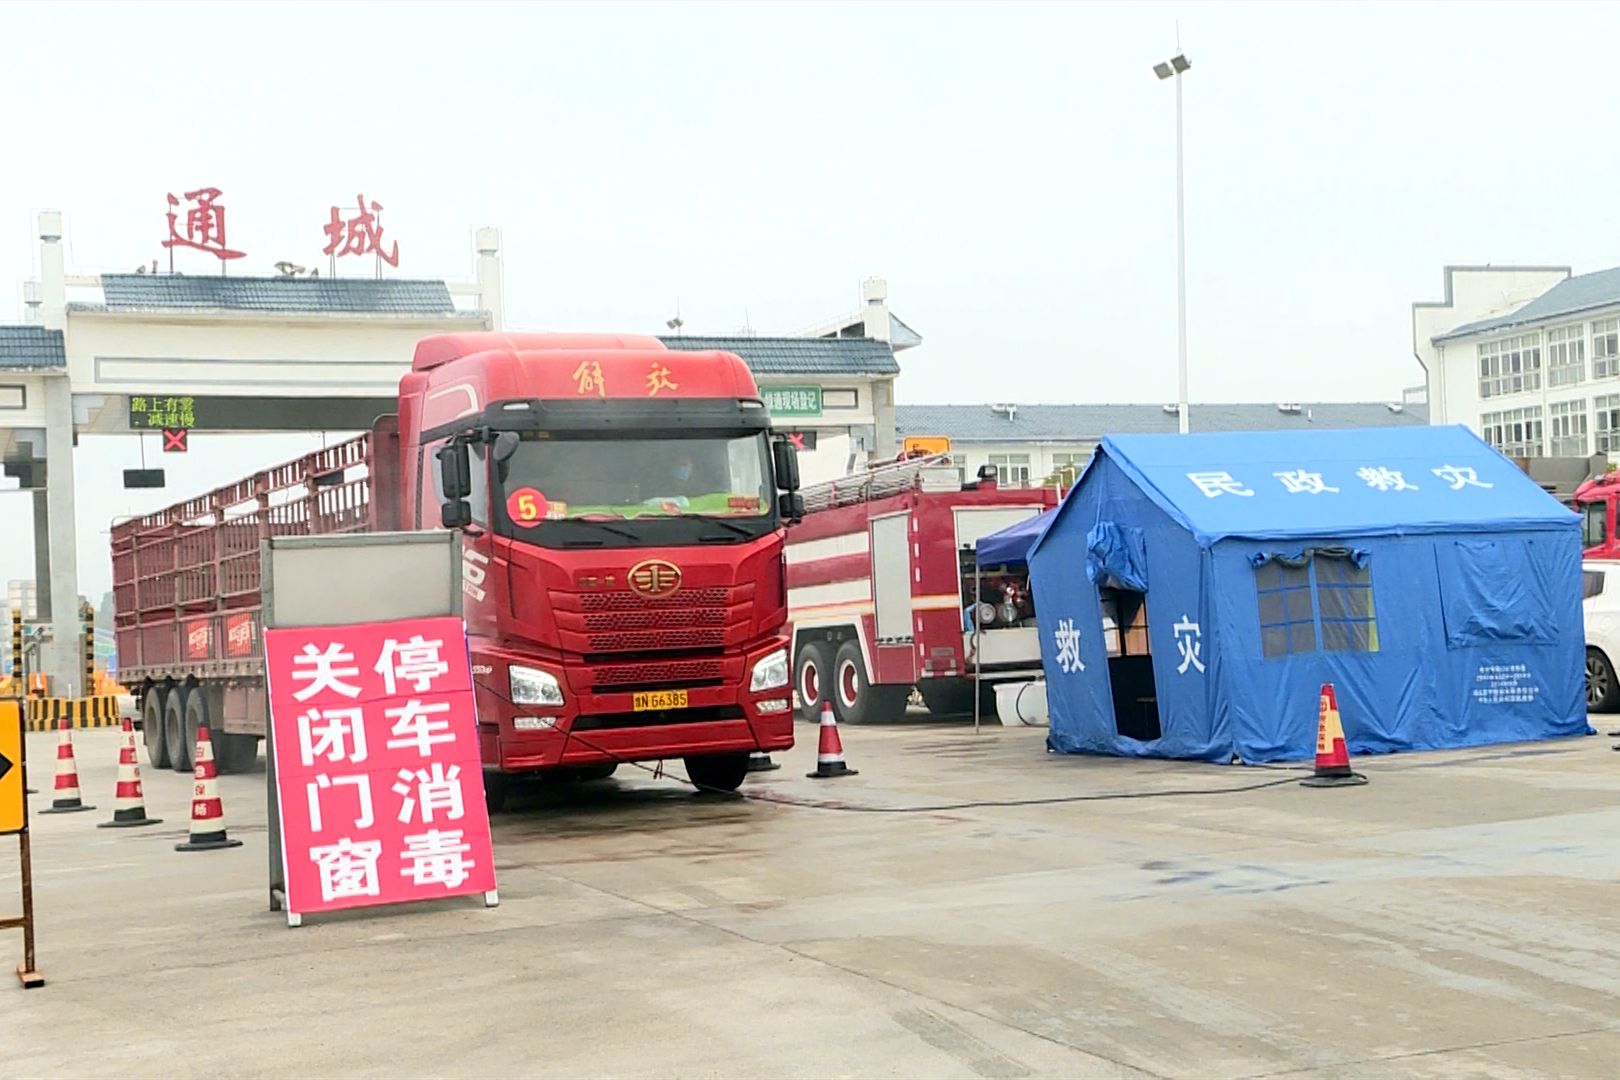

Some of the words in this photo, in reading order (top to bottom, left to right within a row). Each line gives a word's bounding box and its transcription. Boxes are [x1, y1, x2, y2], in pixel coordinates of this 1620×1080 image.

[162, 187, 399, 267] 通城
[572, 360, 679, 397] 解放
[518, 494, 537, 520] 5
[1186, 464, 1494, 499] 民政救灾
[292, 642, 381, 902] 关闭门窗
[374, 636, 475, 889] 停车消毒
